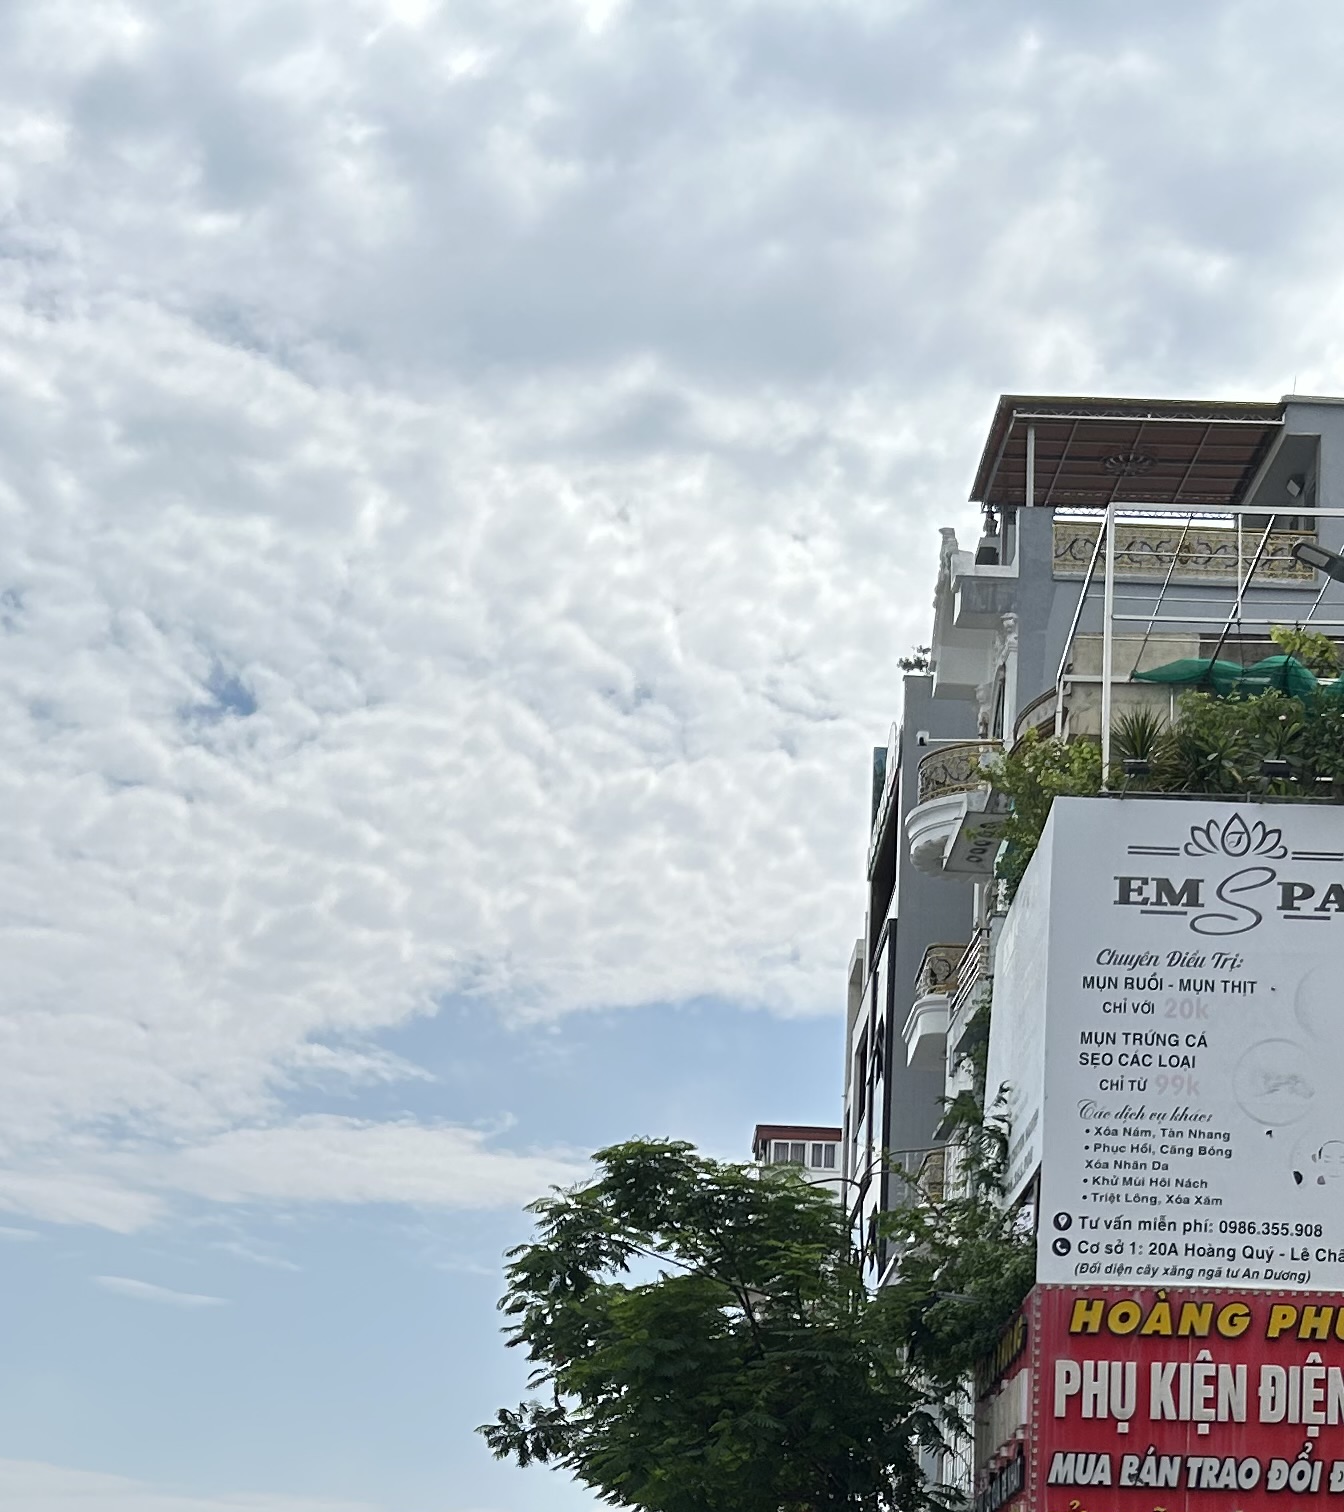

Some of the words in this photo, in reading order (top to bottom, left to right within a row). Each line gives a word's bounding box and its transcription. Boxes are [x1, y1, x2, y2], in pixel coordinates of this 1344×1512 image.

[1113, 875, 1205, 908] EM
[1082, 976, 1118, 992] MỤN
[1124, 972, 1163, 992] RUỒI
[1178, 979, 1216, 995] MỤN
[1221, 980, 1257, 996] THỊT
[1080, 1031, 1116, 1048] MỤN
[1122, 1028, 1180, 1047] TRỨNG
[1185, 1030, 1208, 1048] CÁ
[1079, 1053, 1113, 1070] SẸO
[1118, 1050, 1153, 1067] CÁC
[1158, 1055, 1196, 1070] LOẠI
[1079, 1215, 1105, 1231] Tư
[1107, 1215, 1132, 1231] vấn
[1138, 1214, 1177, 1232] miễn
[1182, 1218, 1214, 1236] phí:
[1218, 1220, 1323, 1238] 0986.355.908
[1077, 1240, 1099, 1256] Cơ
[1104, 1239, 1124, 1256] sở
[1130, 1241, 1143, 1257] 1:
[1148, 1242, 1179, 1257] 20A
[1184, 1243, 1236, 1262] Hoàng
[1241, 1244, 1274, 1263] Quý
[1290, 1246, 1309, 1262] Lê
[1070, 1292, 1252, 1339] HOÀNG
[1054, 1359, 1137, 1434] PHỤ
[1150, 1349, 1248, 1435] KIỆN
[1047, 1452, 1112, 1488] MUA
[1120, 1445, 1182, 1490] BÁN
[1186, 1455, 1262, 1492] TRAO
[1267, 1442, 1322, 1493] ĐỔI
